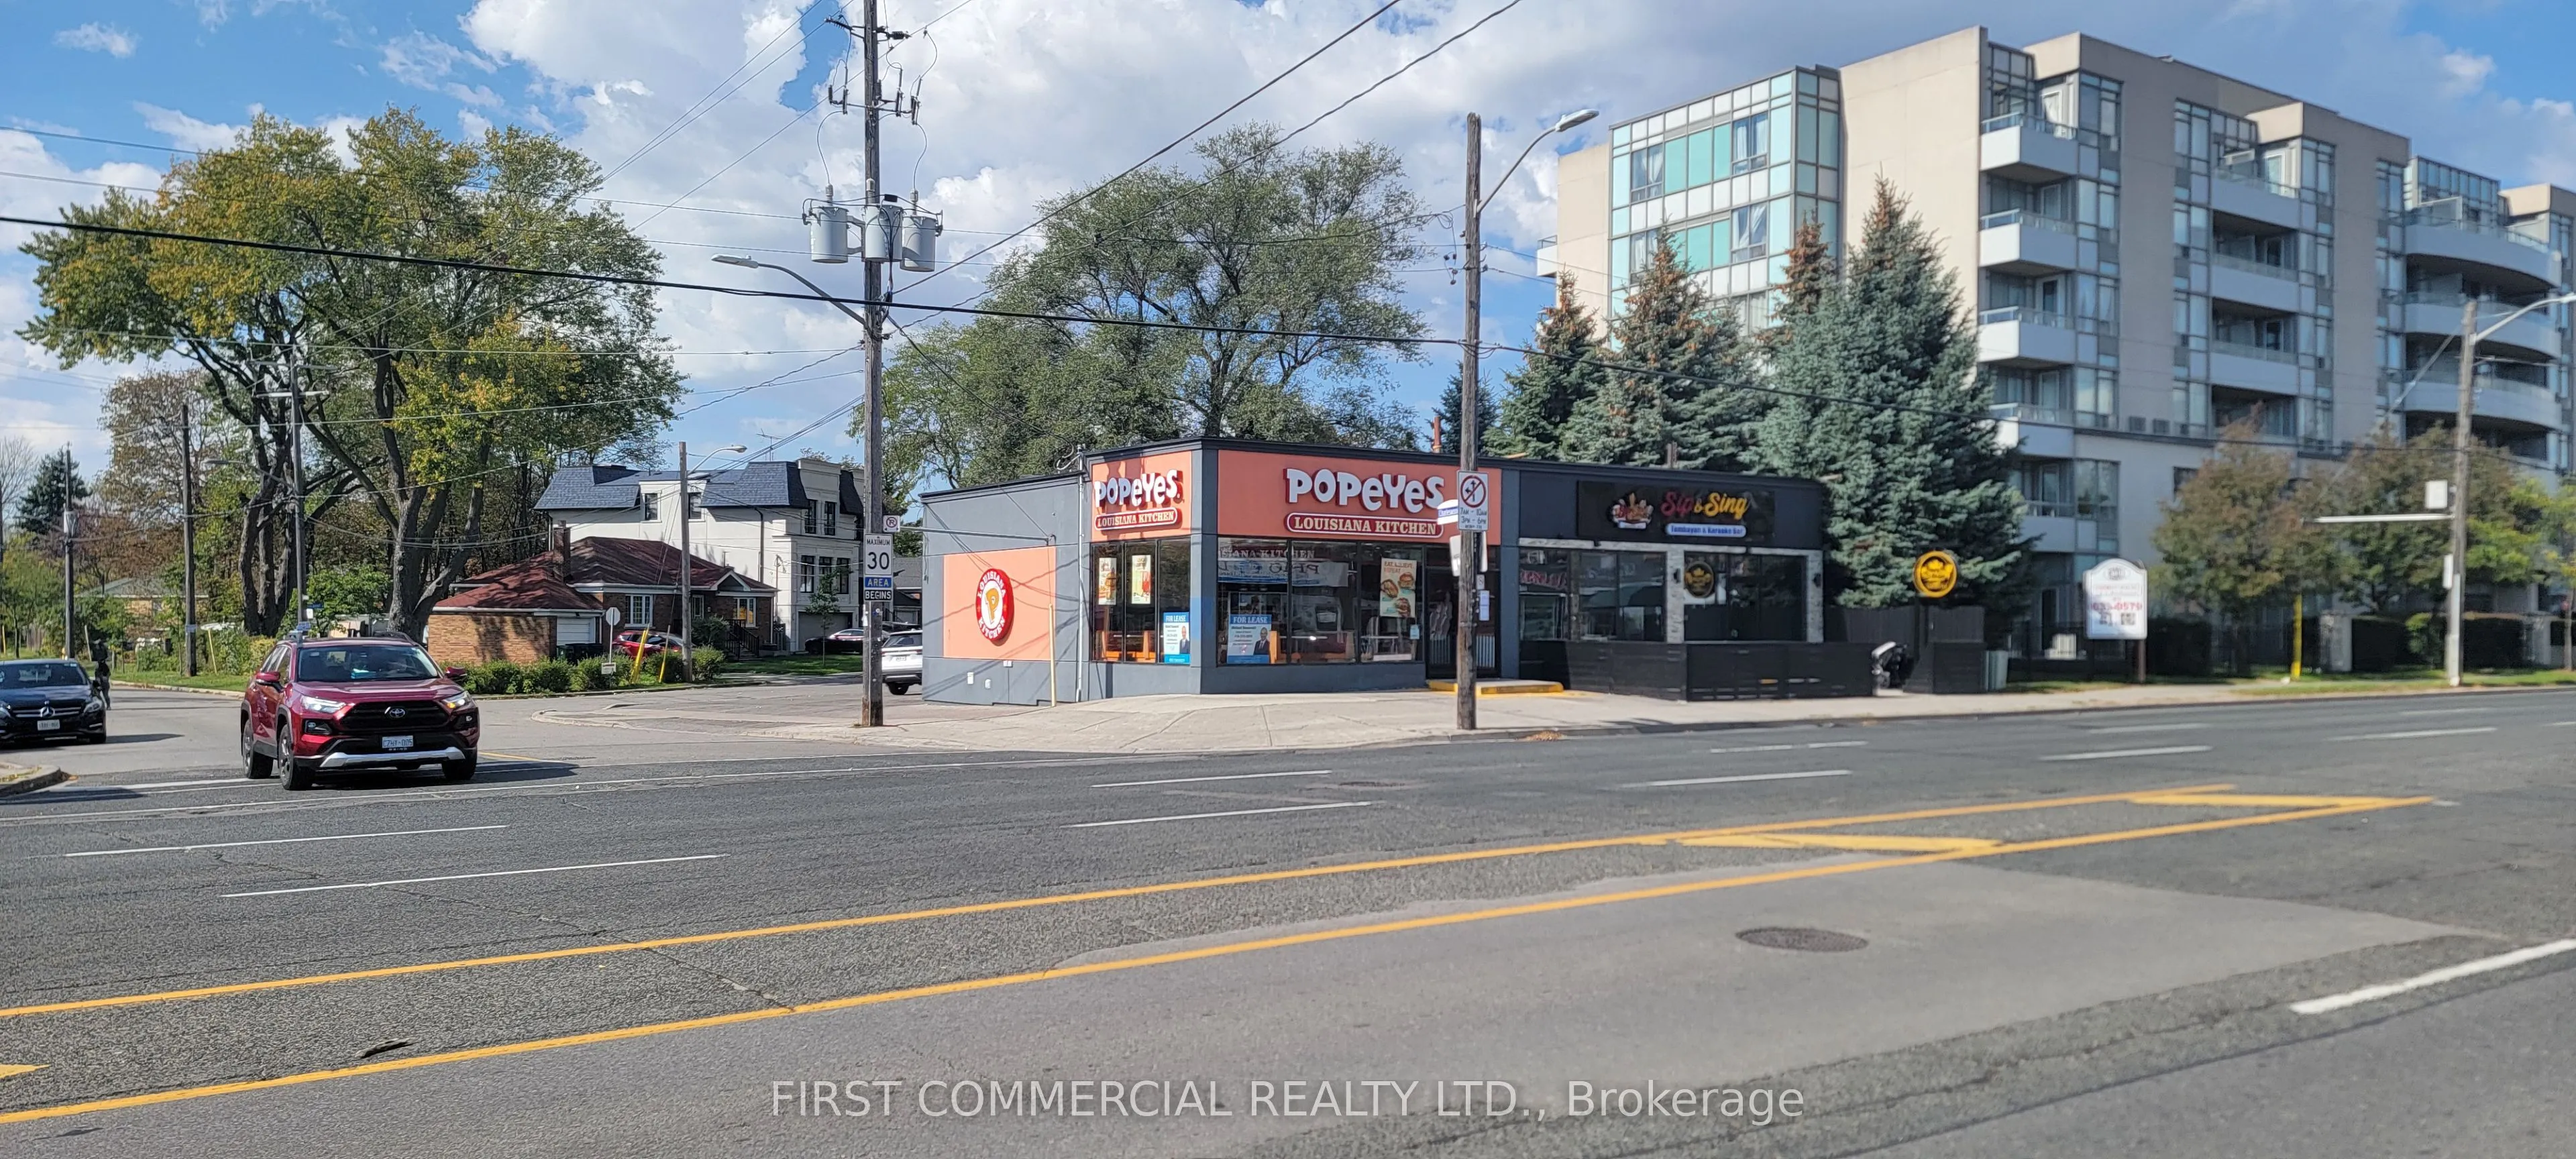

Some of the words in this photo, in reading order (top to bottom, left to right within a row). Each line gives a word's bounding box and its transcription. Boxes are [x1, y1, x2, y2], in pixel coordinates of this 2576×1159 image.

[1705, 492, 1749, 520] Sing
[1097, 516, 1137, 527] LOUISIANA
[1138, 511, 1174, 522] KITCHEN
[1295, 516, 1371, 532] LOUISIANA
[1375, 520, 1437, 535] KITCHEN
[867, 551, 890, 570] 30
[867, 578, 890, 587] AREA
[977, 571, 1006, 598] LOUISIANA
[865, 591, 892, 600] BEGINS
[978, 616, 1006, 639] KITCHEN
